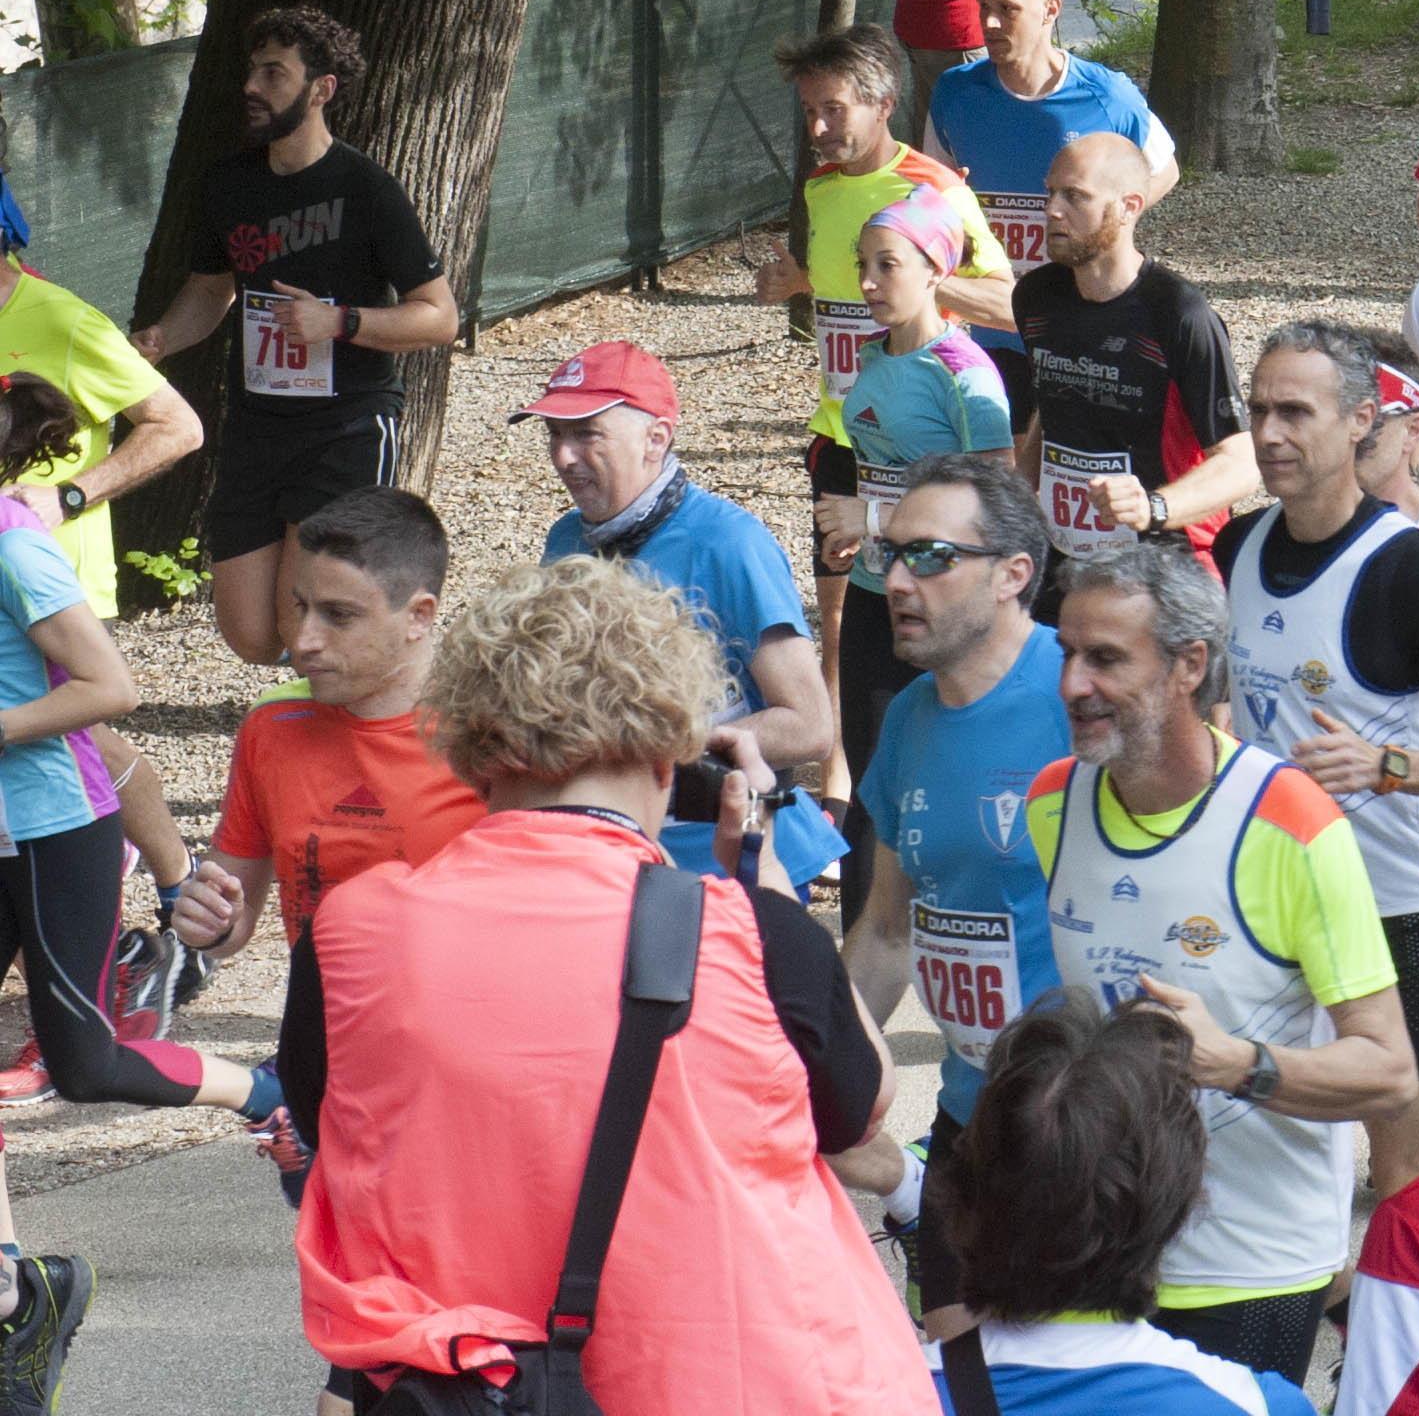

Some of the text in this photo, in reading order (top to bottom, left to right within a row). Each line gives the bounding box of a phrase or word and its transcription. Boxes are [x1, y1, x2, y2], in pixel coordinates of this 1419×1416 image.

[995, 197, 1048, 209] DIADOR
[268, 198, 344, 259] RUN
[256, 325, 308, 370] 715
[1039, 350, 1073, 372] Terre
[1077, 355, 1120, 381] Siena
[292, 377, 329, 390] CRC
[1039, 369, 1144, 397] ULTRAMARATHON 2016
[1060, 453, 1123, 472] DIADORA
[870, 471, 903, 484] DIAD
[927, 915, 1006, 938] DIADORA
[916, 954, 1006, 1031] 1266
